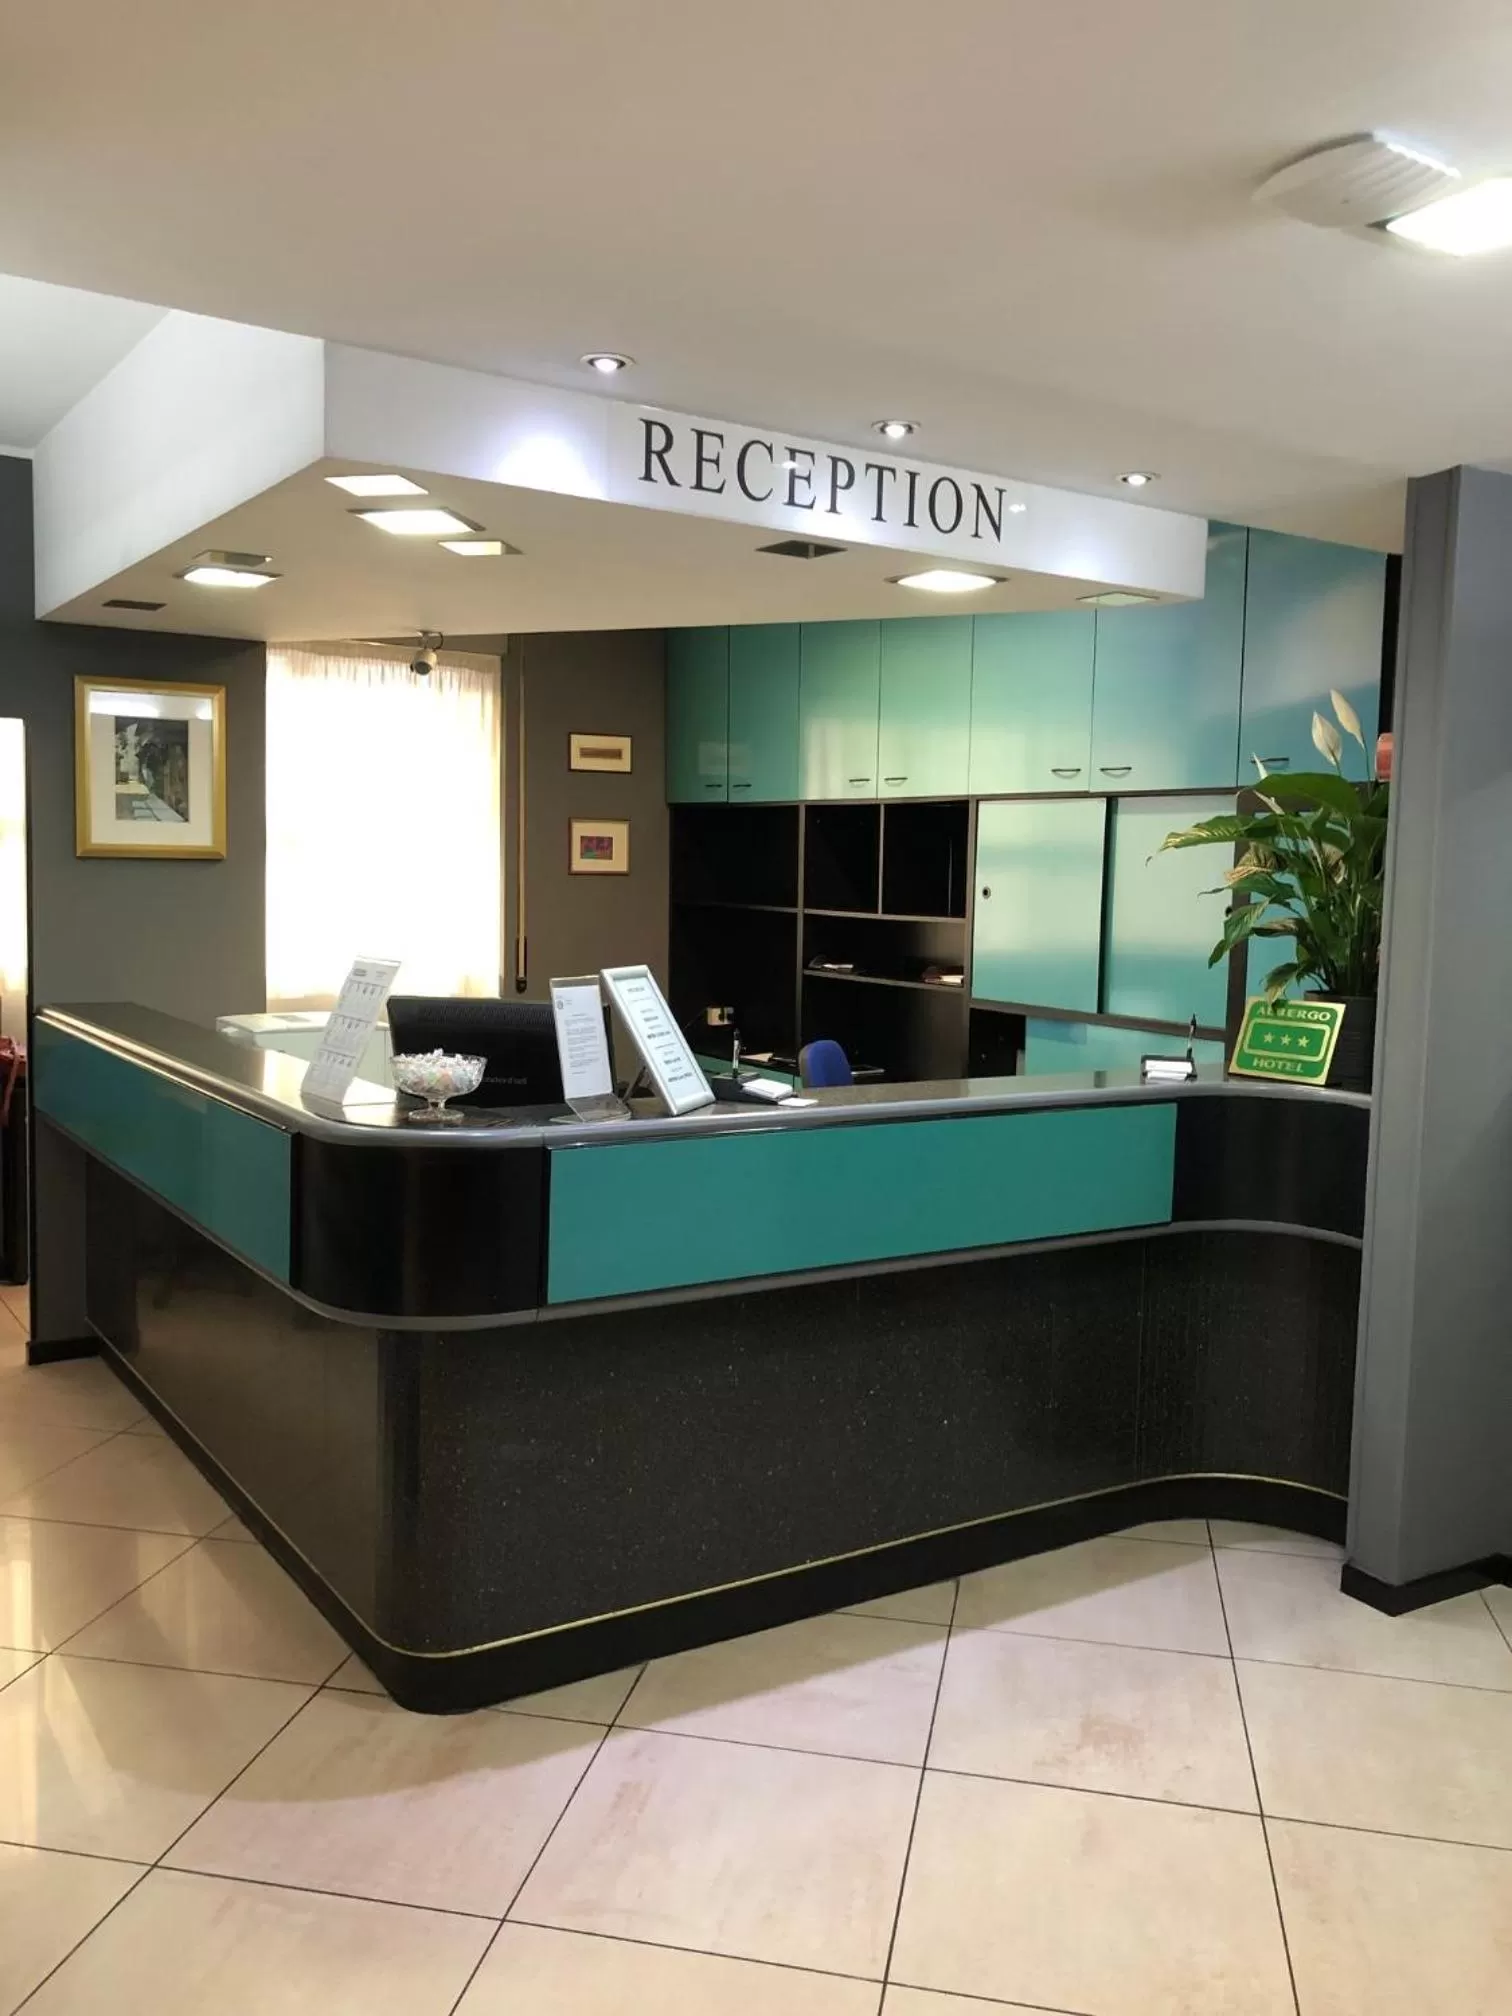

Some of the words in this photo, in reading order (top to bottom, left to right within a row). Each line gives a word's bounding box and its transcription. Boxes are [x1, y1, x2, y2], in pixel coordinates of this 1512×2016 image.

[638, 417, 1007, 543] RECEPTION
[1257, 1006, 1331, 1021] ALBERGO
[1253, 1058, 1303, 1072] HOTEL
